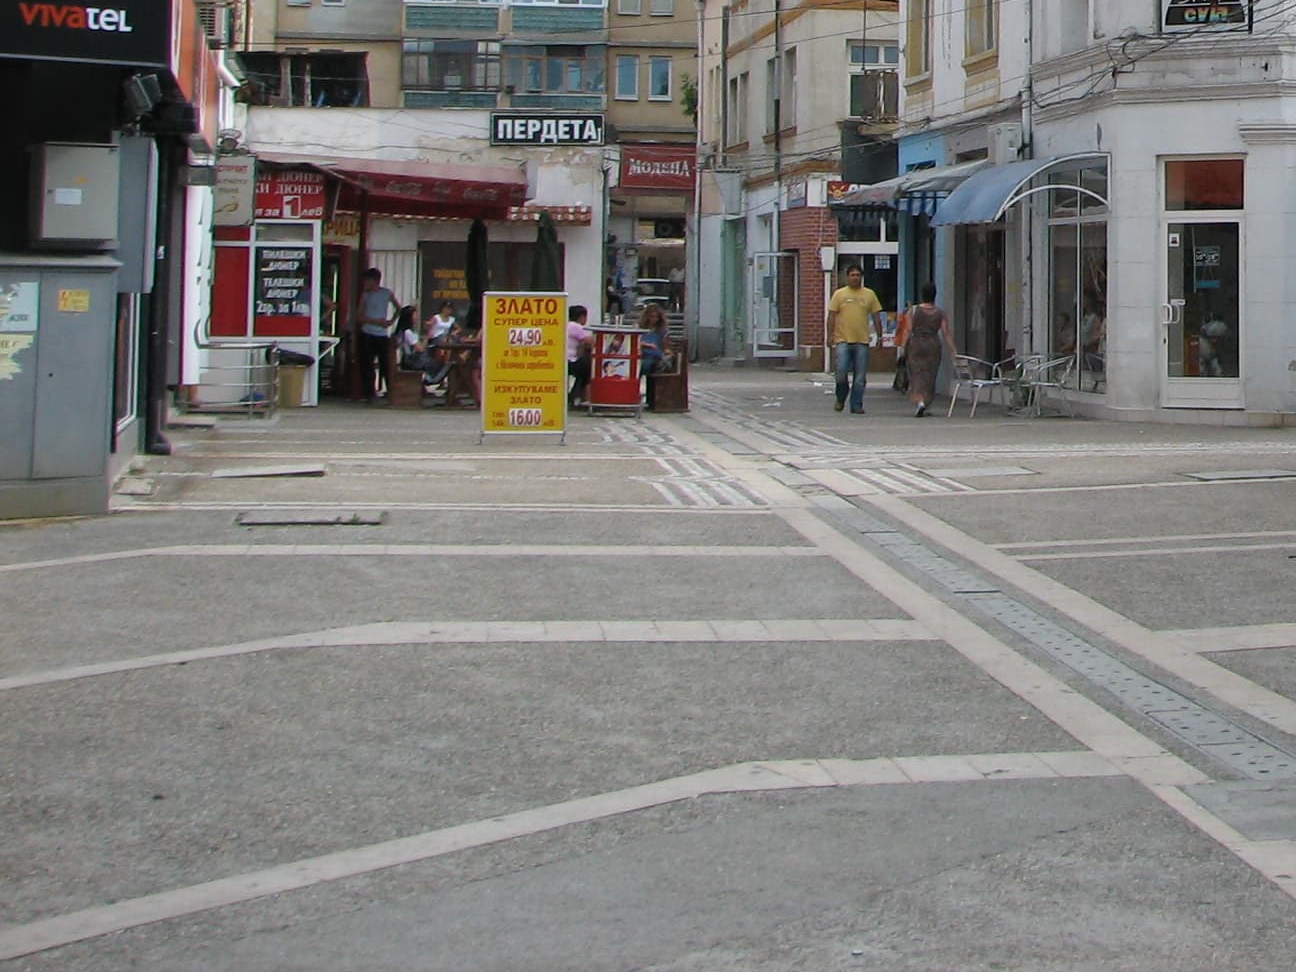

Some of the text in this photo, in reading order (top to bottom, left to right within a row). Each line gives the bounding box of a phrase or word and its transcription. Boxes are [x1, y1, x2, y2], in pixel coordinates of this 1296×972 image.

[18, 1, 134, 33] vivatel
[497, 119, 598, 143] ПЕРДЕТА
[495, 298, 558, 315] ЗЛАТО
[494, 318, 559, 328] СУПЕР ЦЕНА
[509, 329, 542, 345] 24.90
[510, 395, 542, 405] ЗЛАТО
